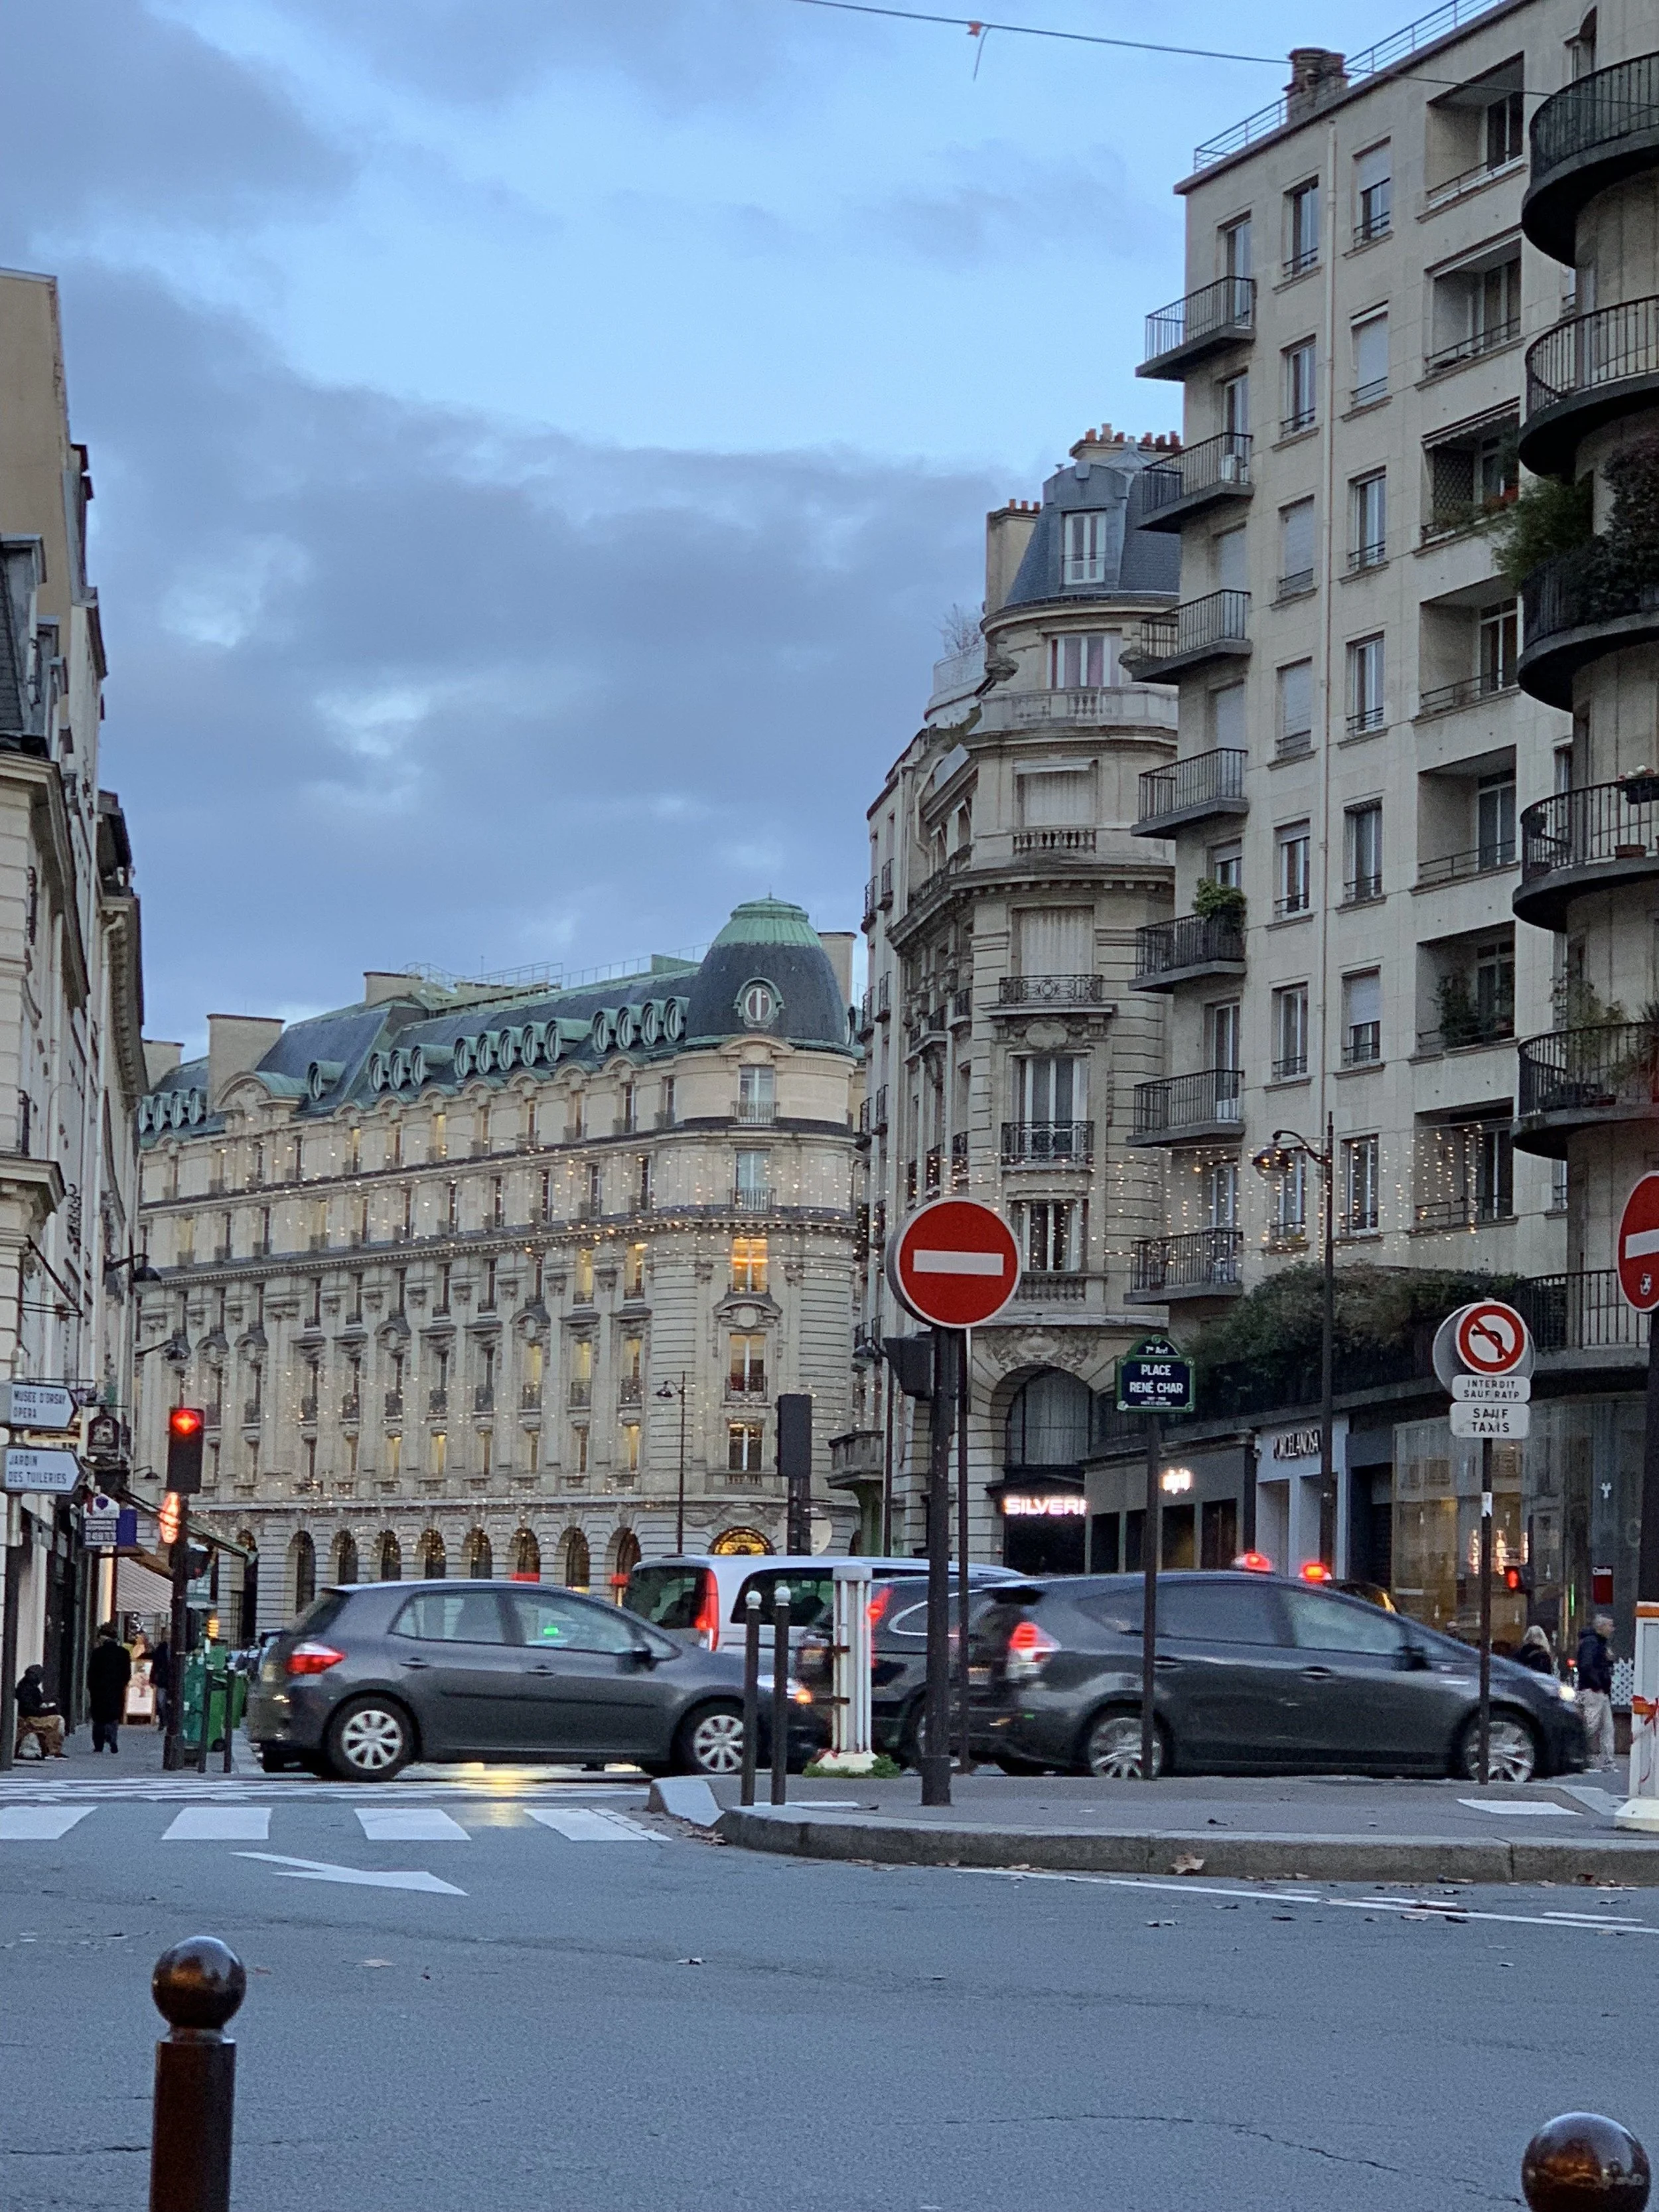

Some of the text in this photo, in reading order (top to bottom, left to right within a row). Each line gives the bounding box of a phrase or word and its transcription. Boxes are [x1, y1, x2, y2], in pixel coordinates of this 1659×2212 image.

[1141, 1364, 1171, 1376] PLACE
[1129, 1380, 1183, 1394] RENÉ CHAR
[1467, 1379, 1515, 1389] INTERDIT
[1494, 1390, 1520, 1399] RATP
[13, 1406, 37, 1419] OPERA
[1473, 1408, 1508, 1419] SAUF
[1472, 1422, 1510, 1433] TAXIS
[9, 1454, 38, 1466] JARDIN
[8, 1471, 66, 1484] DES TUILERIES
